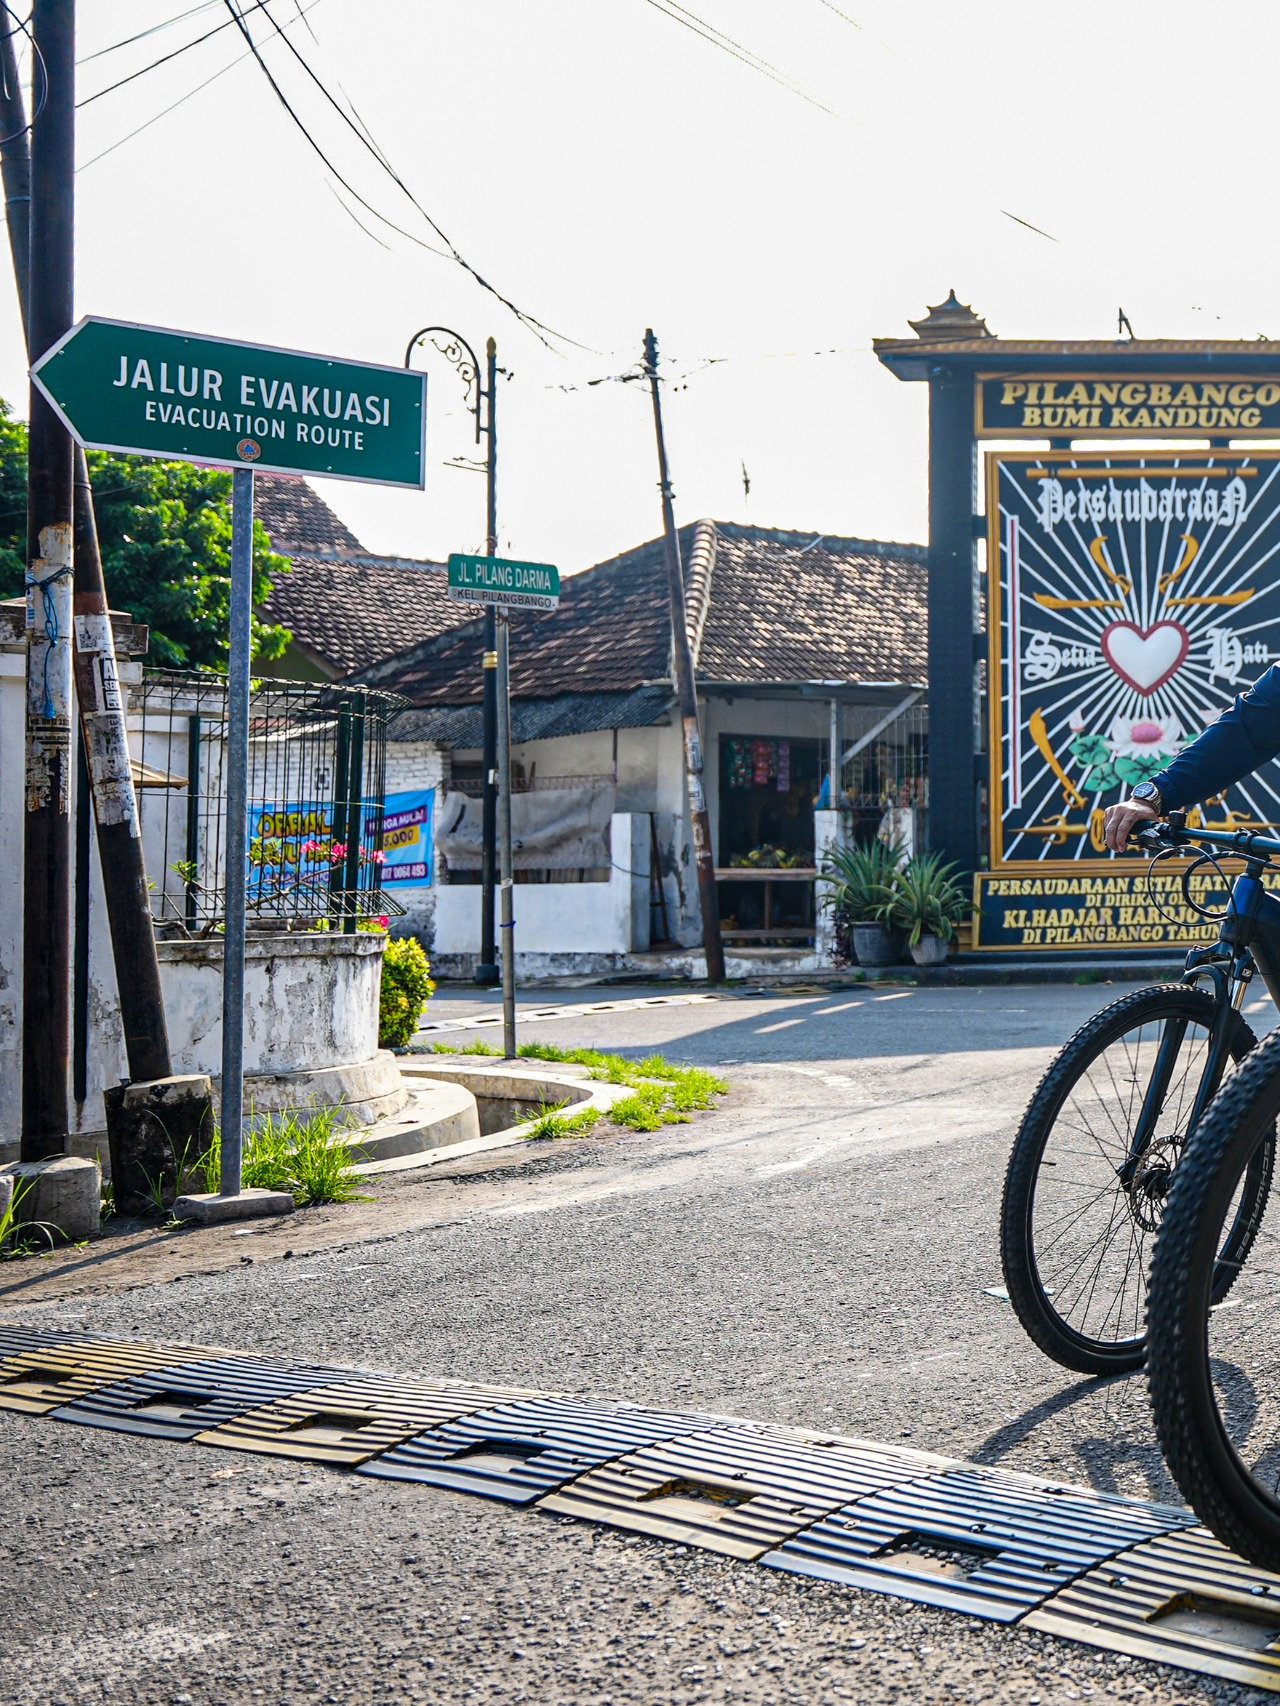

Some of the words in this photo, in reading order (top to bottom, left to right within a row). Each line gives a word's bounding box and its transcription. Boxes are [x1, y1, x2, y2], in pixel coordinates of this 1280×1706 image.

[113, 355, 223, 401] JALUR
[240, 375, 390, 427] EVAKUASI
[145, 401, 286, 439] EVACUATION
[296, 422, 364, 451] ROUTE
[1021, 407, 1103, 428] BUMI
[1109, 407, 1263, 428] KANDUNG
[458, 562, 473, 583] JL.
[475, 563, 513, 587] PILANG
[515, 568, 551, 590] DARMA
[482, 591, 552, 608] PILANGBANGO
[1024, 630, 1097, 681] Setia
[1206, 627, 1268, 686] Hati
[987, 877, 1131, 896] PERSAUDARAAN
[1132, 876, 1183, 893] SETIA
[1085, 893, 1102, 908] DI
[1105, 893, 1167, 907] DIRIKAN
[1003, 908, 1114, 928] KI.HADJAR
[1117, 906, 1200, 925] HARDJO
[1022, 928, 1041, 943] DI
[1045, 925, 1164, 943] PILANGBANGO
[1166, 923, 1220, 940] TAHUN
[1235, 1141, 1271, 1261] SCHWALBE
